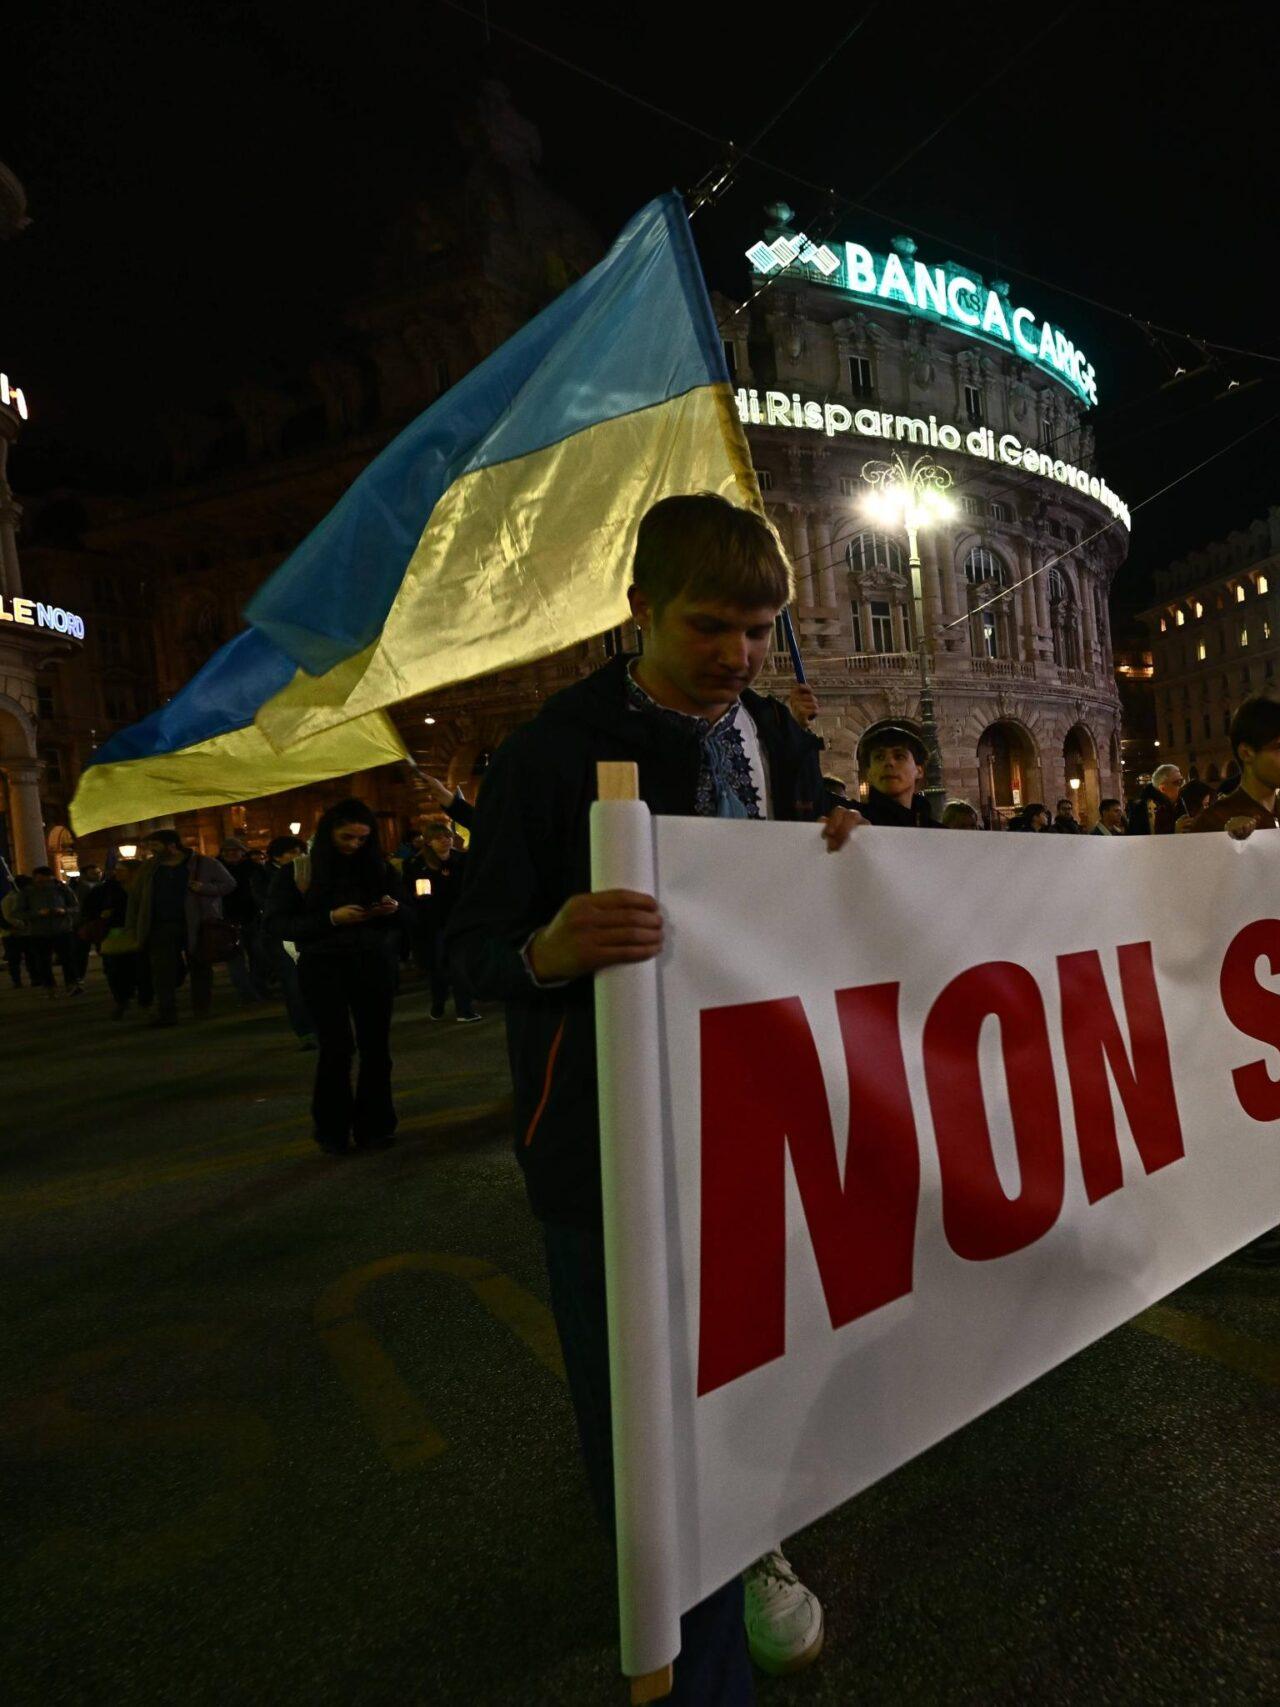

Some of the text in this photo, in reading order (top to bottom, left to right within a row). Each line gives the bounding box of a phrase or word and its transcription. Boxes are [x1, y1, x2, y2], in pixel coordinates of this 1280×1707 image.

[766, 391, 961, 450] Risparmio
[966, 427, 995, 460] di
[998, 434, 1090, 496] Genova
[696, 941, 1185, 1398] NON
